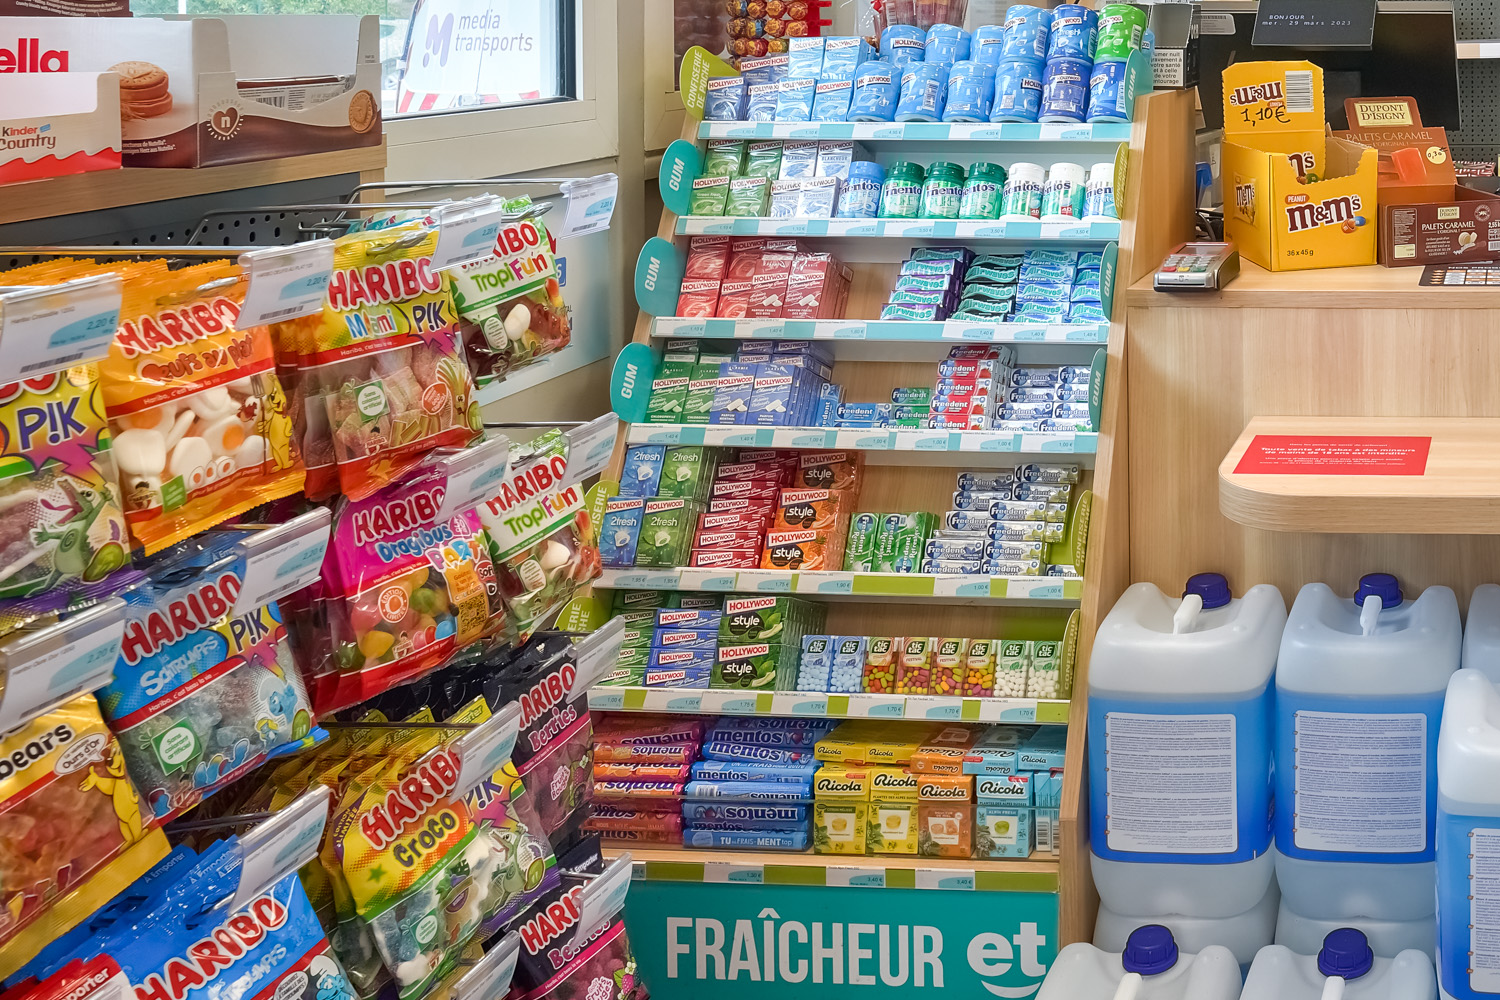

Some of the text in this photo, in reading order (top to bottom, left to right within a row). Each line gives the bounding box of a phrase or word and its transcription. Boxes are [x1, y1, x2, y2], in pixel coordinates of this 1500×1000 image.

[458, 10, 500, 31] media
[455, 31, 533, 54] transports
[687, 50, 703, 108] CONFISERIE
[1361, 112, 1405, 121] D'ISIGNY
[2, 126, 38, 137] Kinder
[1346, 132, 1432, 142] PALETS CARAMEL
[1288, 195, 1306, 203] PEANUT
[1286, 195, 1361, 232] m&m's
[1422, 221, 1475, 230] PALETS CARAMEL
[644, 256, 661, 291] GUM
[328, 257, 441, 310] HARIBO
[882, 305, 932, 320] Airwaves
[114, 296, 243, 357] HARIBO
[940, 364, 975, 375] Freedent
[621, 363, 638, 399] GUM
[756, 378, 792, 387] HOLLYWOOD
[634, 451, 660, 461] 2fresh
[771, 532, 815, 543] HOLLYWOOD
[773, 548, 800, 559] style
[927, 546, 963, 555] Freedent
[121, 573, 243, 666] HARIBO
[662, 612, 698, 622] HOLLYWOOD
[721, 646, 767, 659] HOLLYWOOD
[528, 703, 578, 753] Berries
[697, 770, 748, 781] mentos
[817, 778, 862, 793] Ricola
[980, 780, 1024, 795] Ricola
[720, 837, 731, 846] TU
[666, 907, 1047, 988] FRAÎCHEUR et
